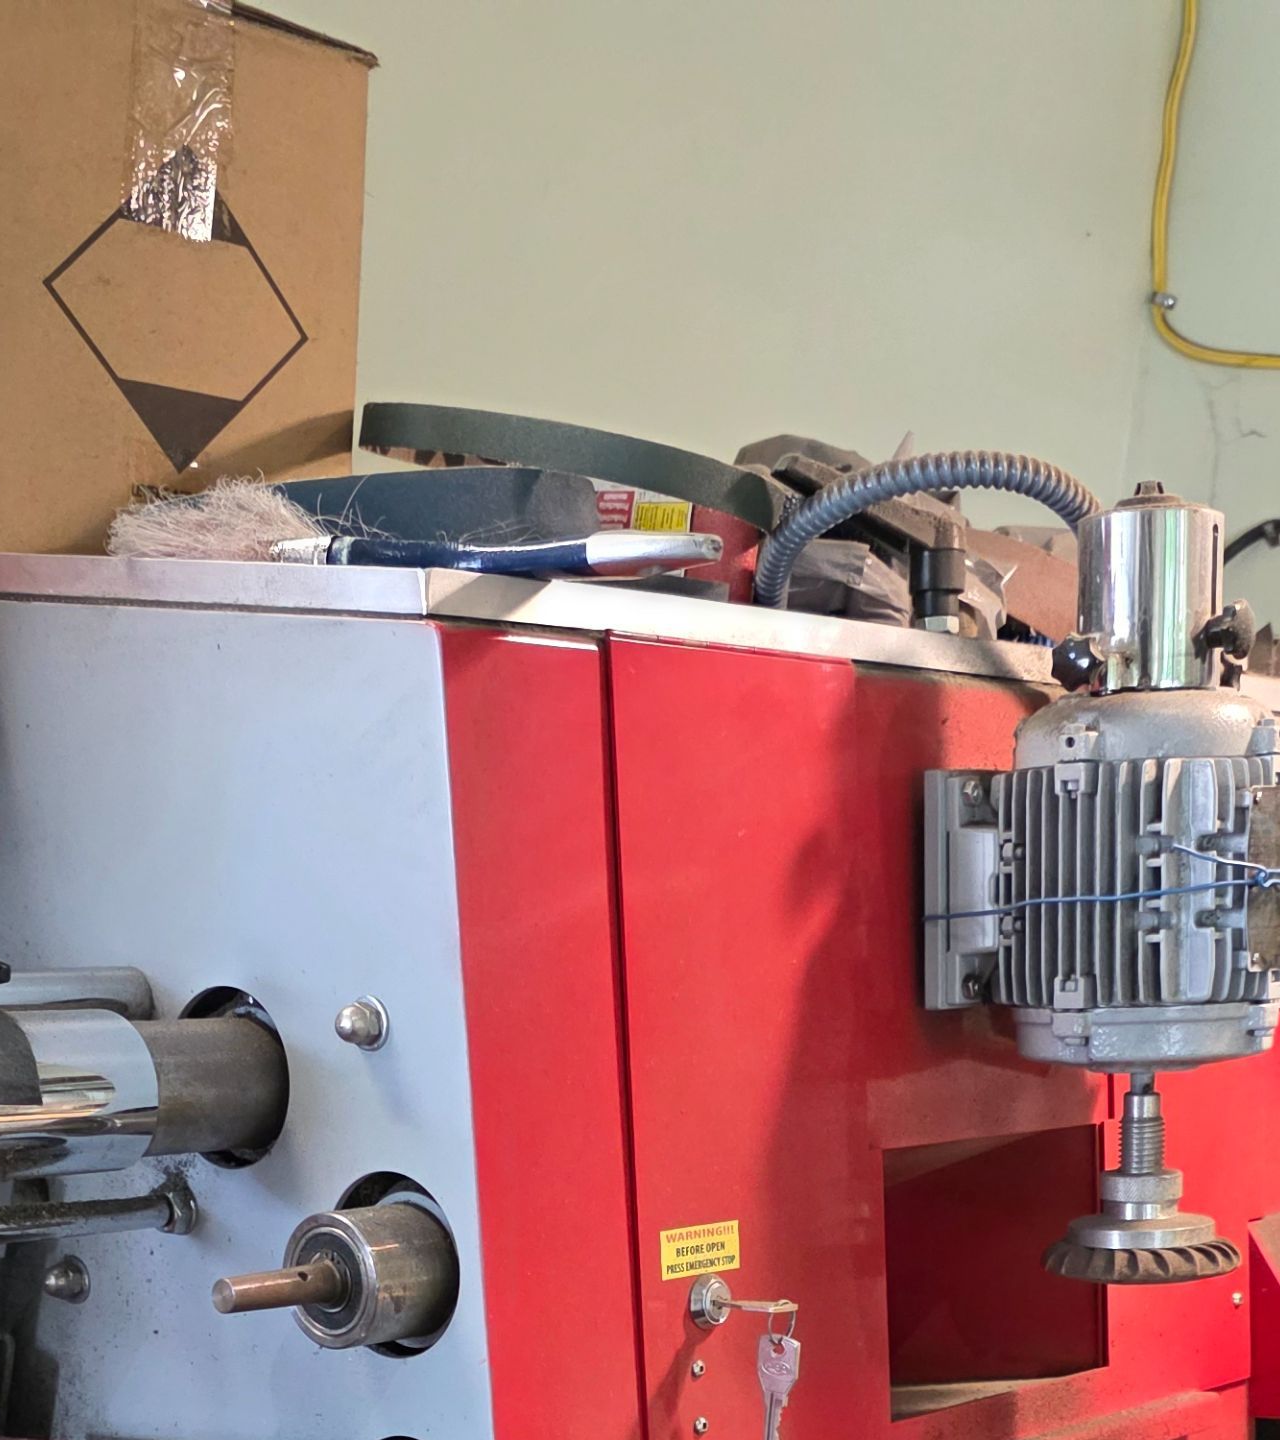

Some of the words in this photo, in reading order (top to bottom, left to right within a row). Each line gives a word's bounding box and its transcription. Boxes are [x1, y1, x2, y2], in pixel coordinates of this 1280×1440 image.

[666, 1225, 735, 1243] WARNING!!!
[676, 1244, 705, 1257] BEFORE
[706, 1241, 726, 1253] OPEN
[666, 1263, 685, 1275] PRESS
[685, 1256, 721, 1271] EMERGENCY
[721, 1254, 736, 1266] STOP
